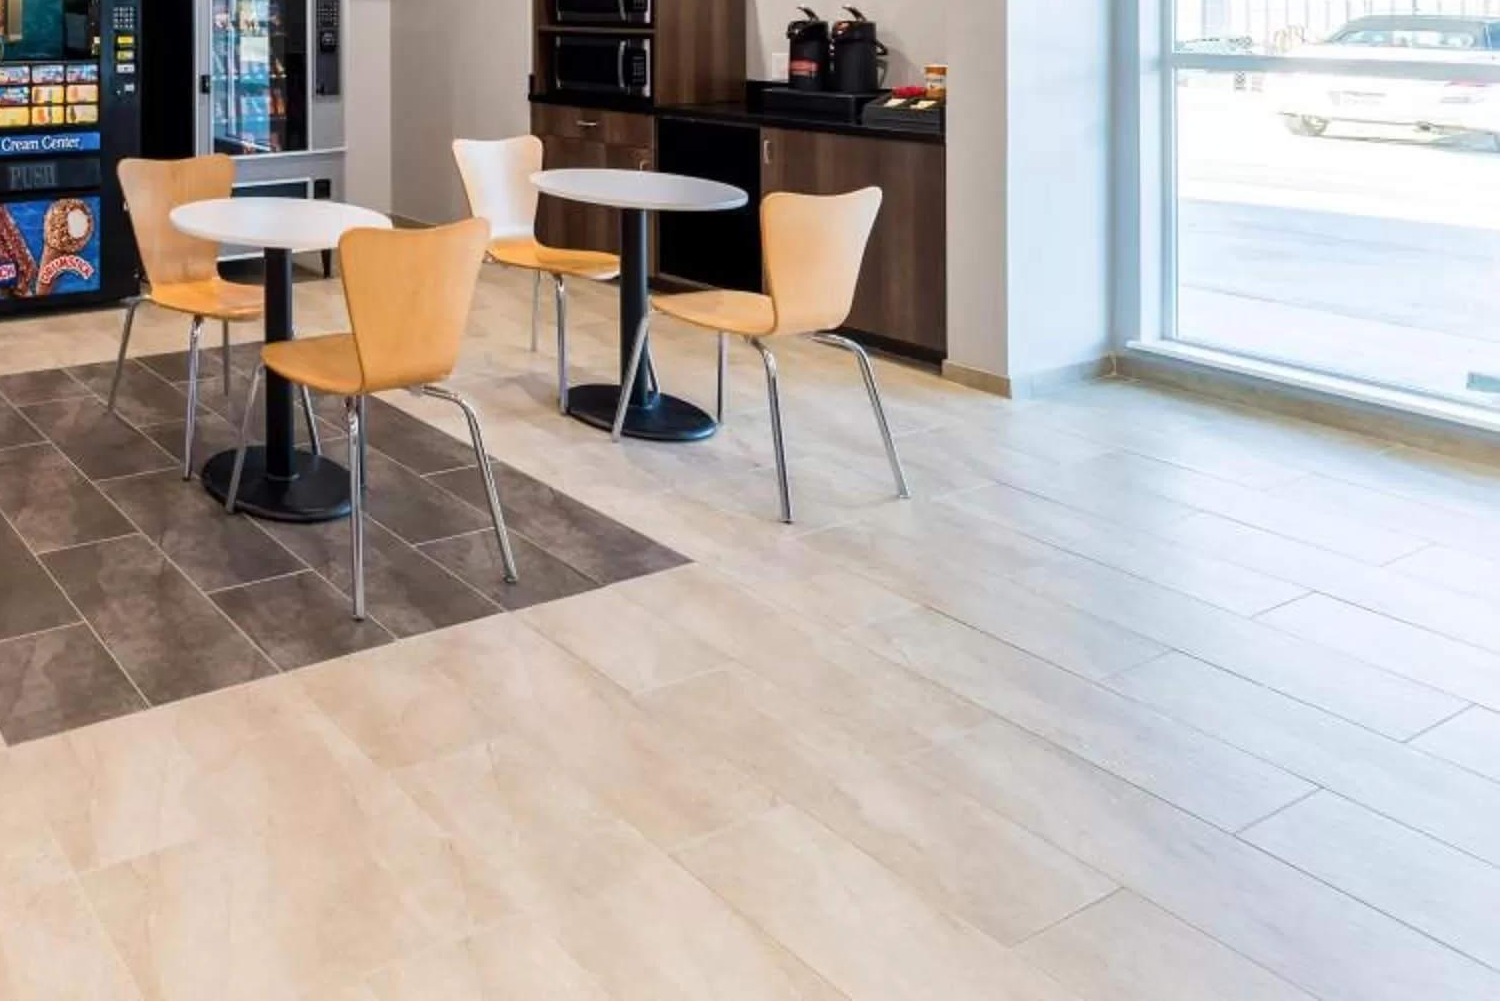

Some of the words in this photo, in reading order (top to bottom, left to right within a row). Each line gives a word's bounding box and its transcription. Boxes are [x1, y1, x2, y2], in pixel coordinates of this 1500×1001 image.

[1, 135, 39, 152] Cream
[41, 133, 81, 150] Center
[9, 162, 58, 190] PUSH
